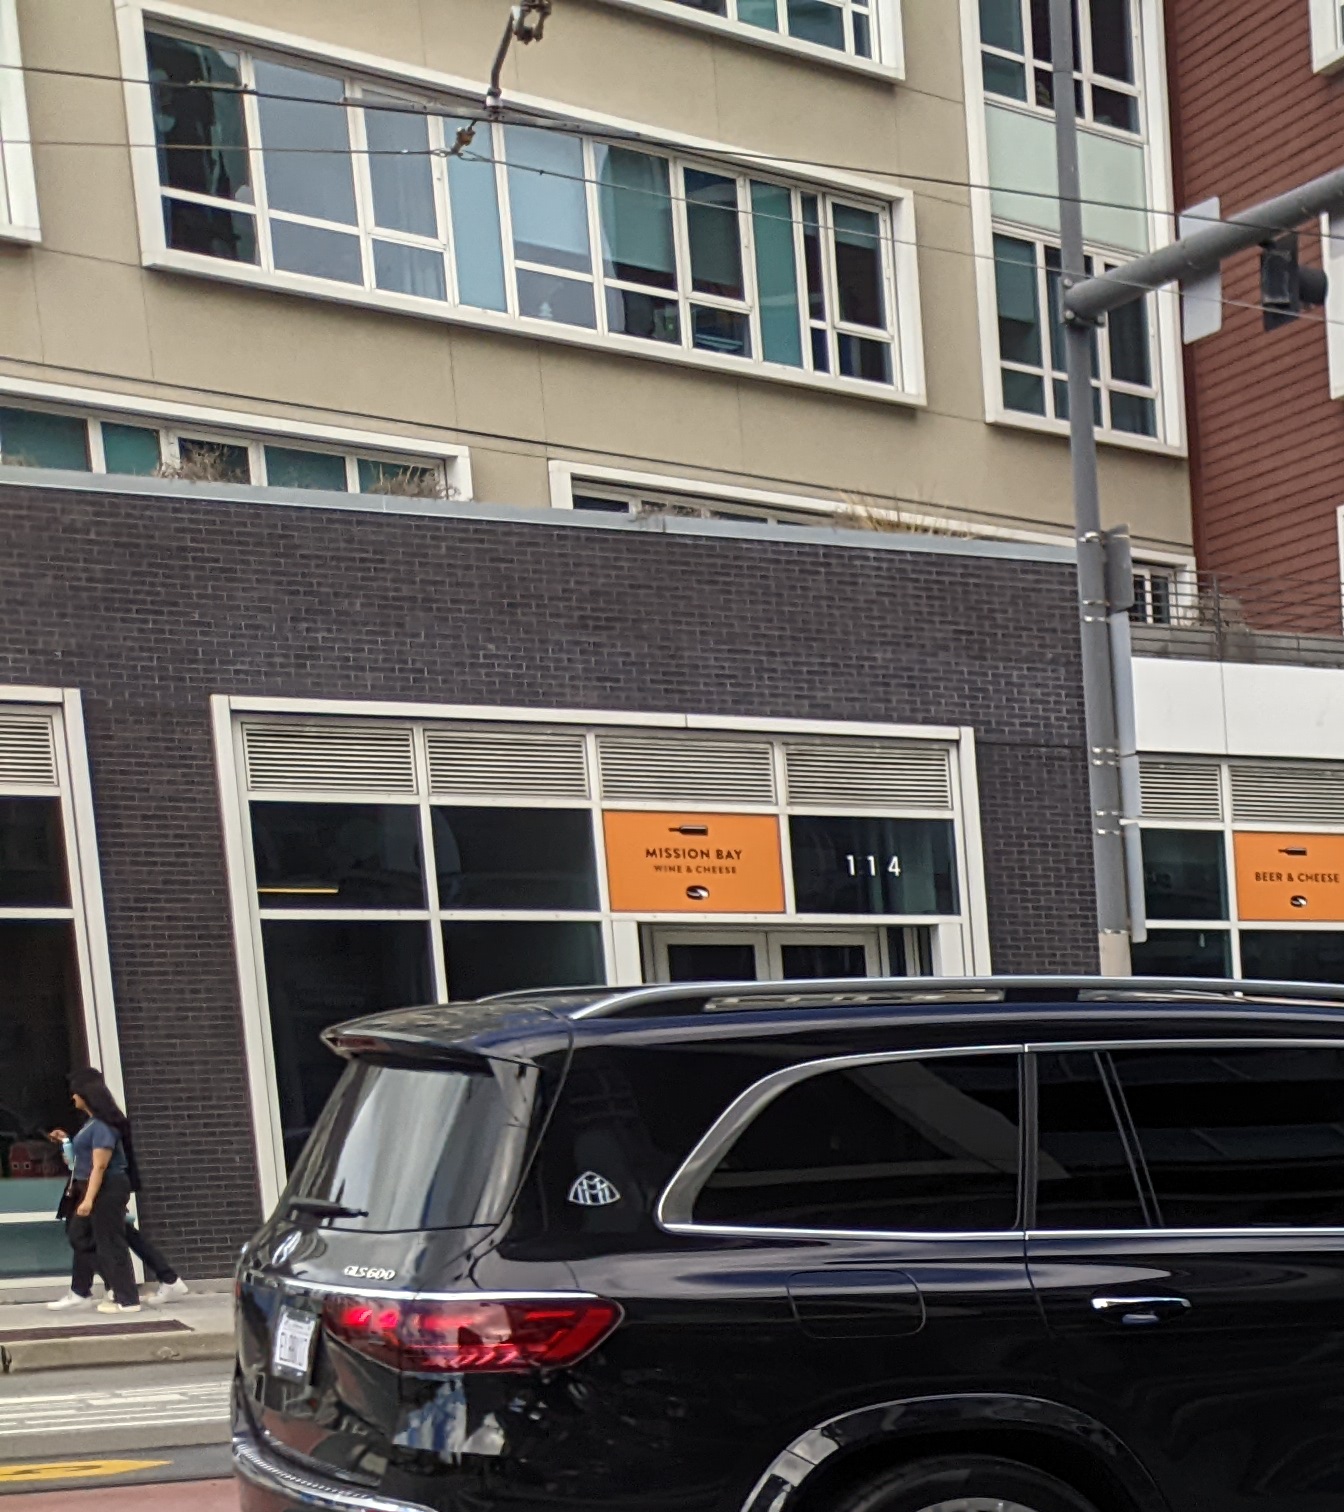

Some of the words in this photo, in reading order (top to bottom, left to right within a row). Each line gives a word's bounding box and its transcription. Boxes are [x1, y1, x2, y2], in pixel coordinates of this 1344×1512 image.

[645, 848, 710, 860] MISSION
[716, 849, 743, 860] BAY
[653, 865, 683, 874] WINE
[686, 866, 692, 874] &
[697, 866, 737, 874] CHEESE
[846, 855, 901, 876] 114
[1255, 871, 1283, 883] BEER
[1287, 873, 1294, 882] &
[1297, 872, 1340, 884] CHEESE
